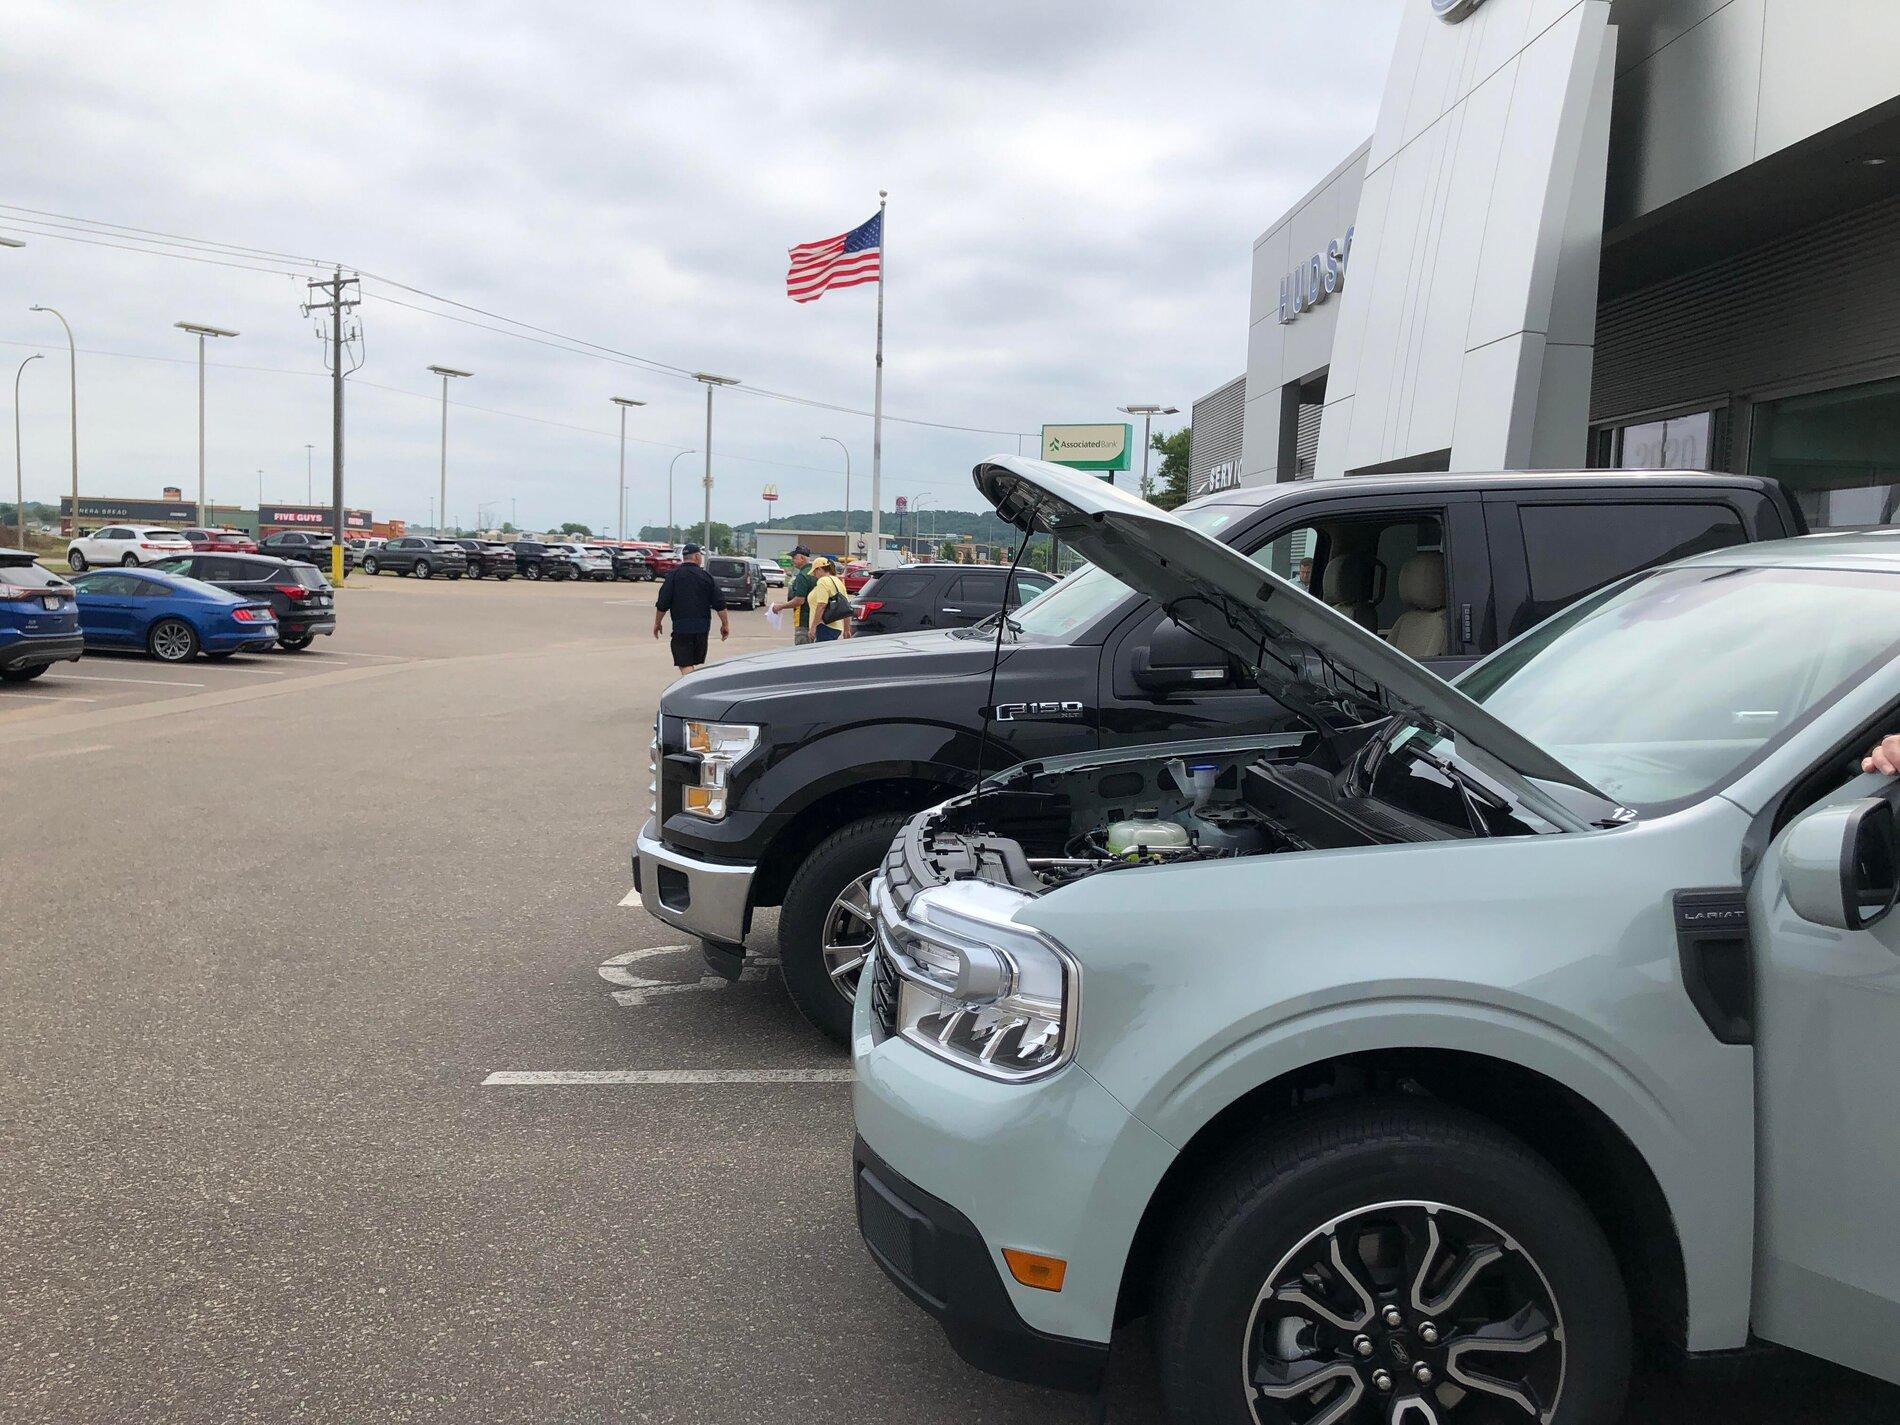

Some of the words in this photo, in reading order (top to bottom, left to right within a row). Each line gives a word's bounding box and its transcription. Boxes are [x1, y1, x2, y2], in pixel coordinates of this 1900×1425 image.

[273, 512, 295, 522] FIVE
[296, 513, 323, 522] GUYS
[1684, 910, 1745, 920] LARIAT
